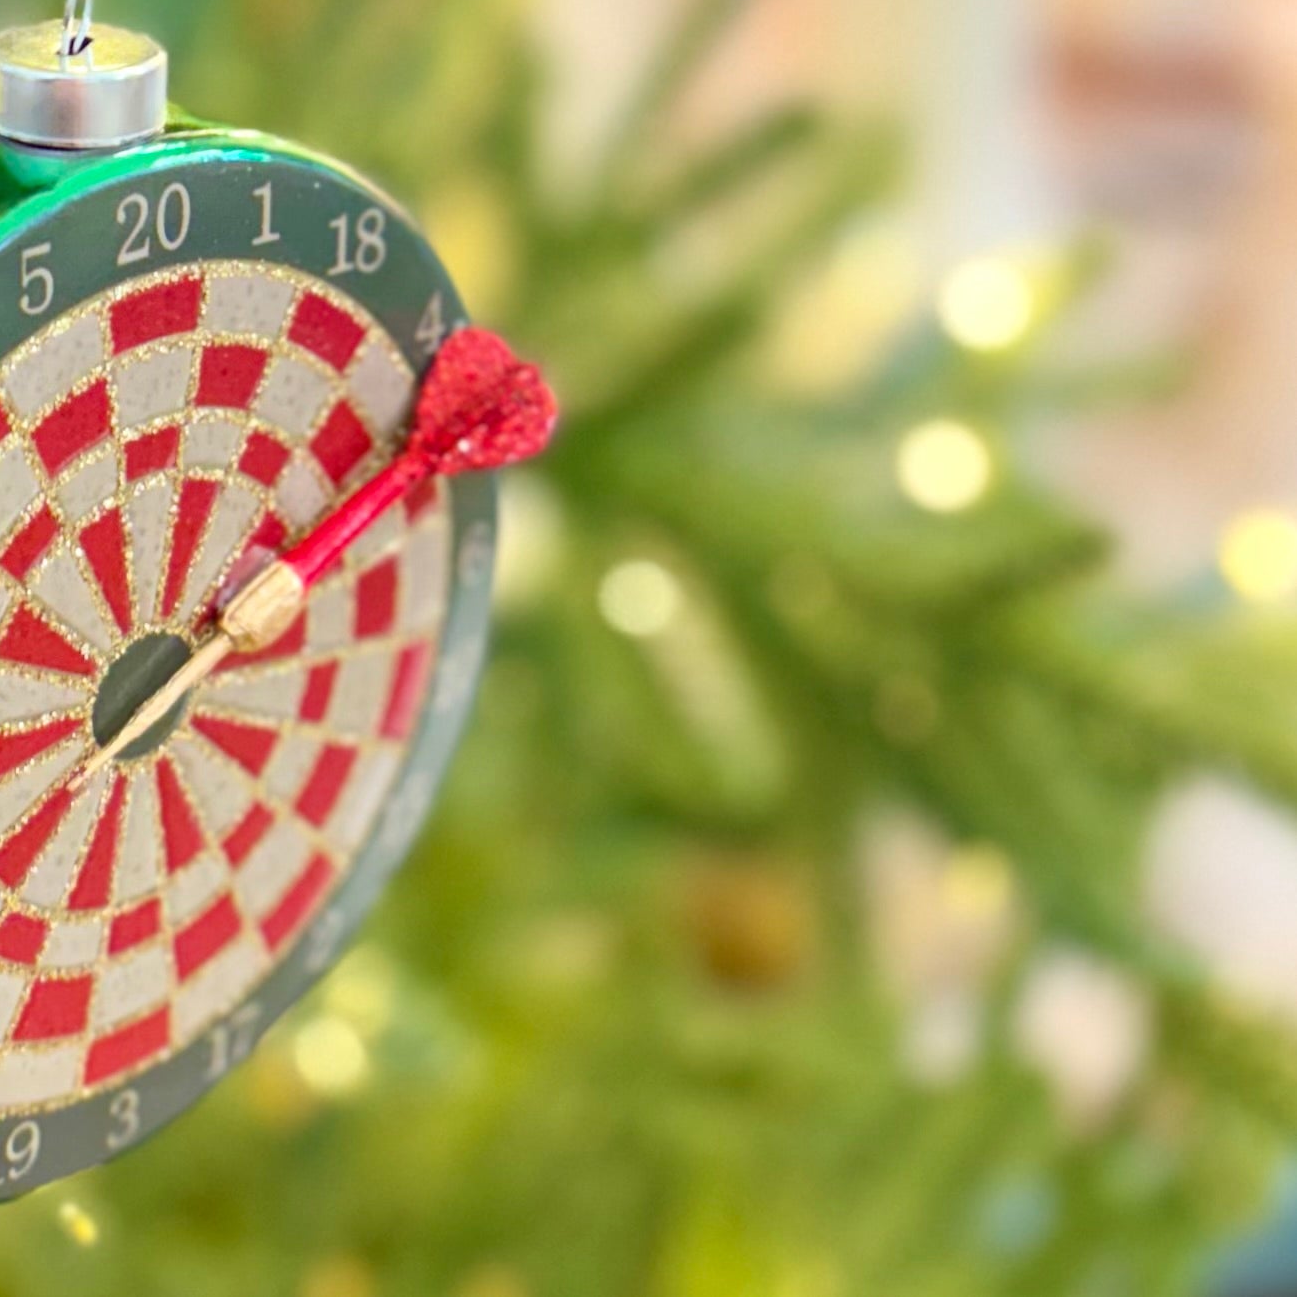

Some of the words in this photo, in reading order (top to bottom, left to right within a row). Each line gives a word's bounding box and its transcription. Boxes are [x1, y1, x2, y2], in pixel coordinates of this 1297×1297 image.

[117, 182, 191, 266] 20
[252, 181, 280, 245] 1
[327, 208, 386, 276] 18
[20, 242, 54, 315] 5
[414, 289, 447, 354] 4
[107, 1089, 139, 1148] 3
